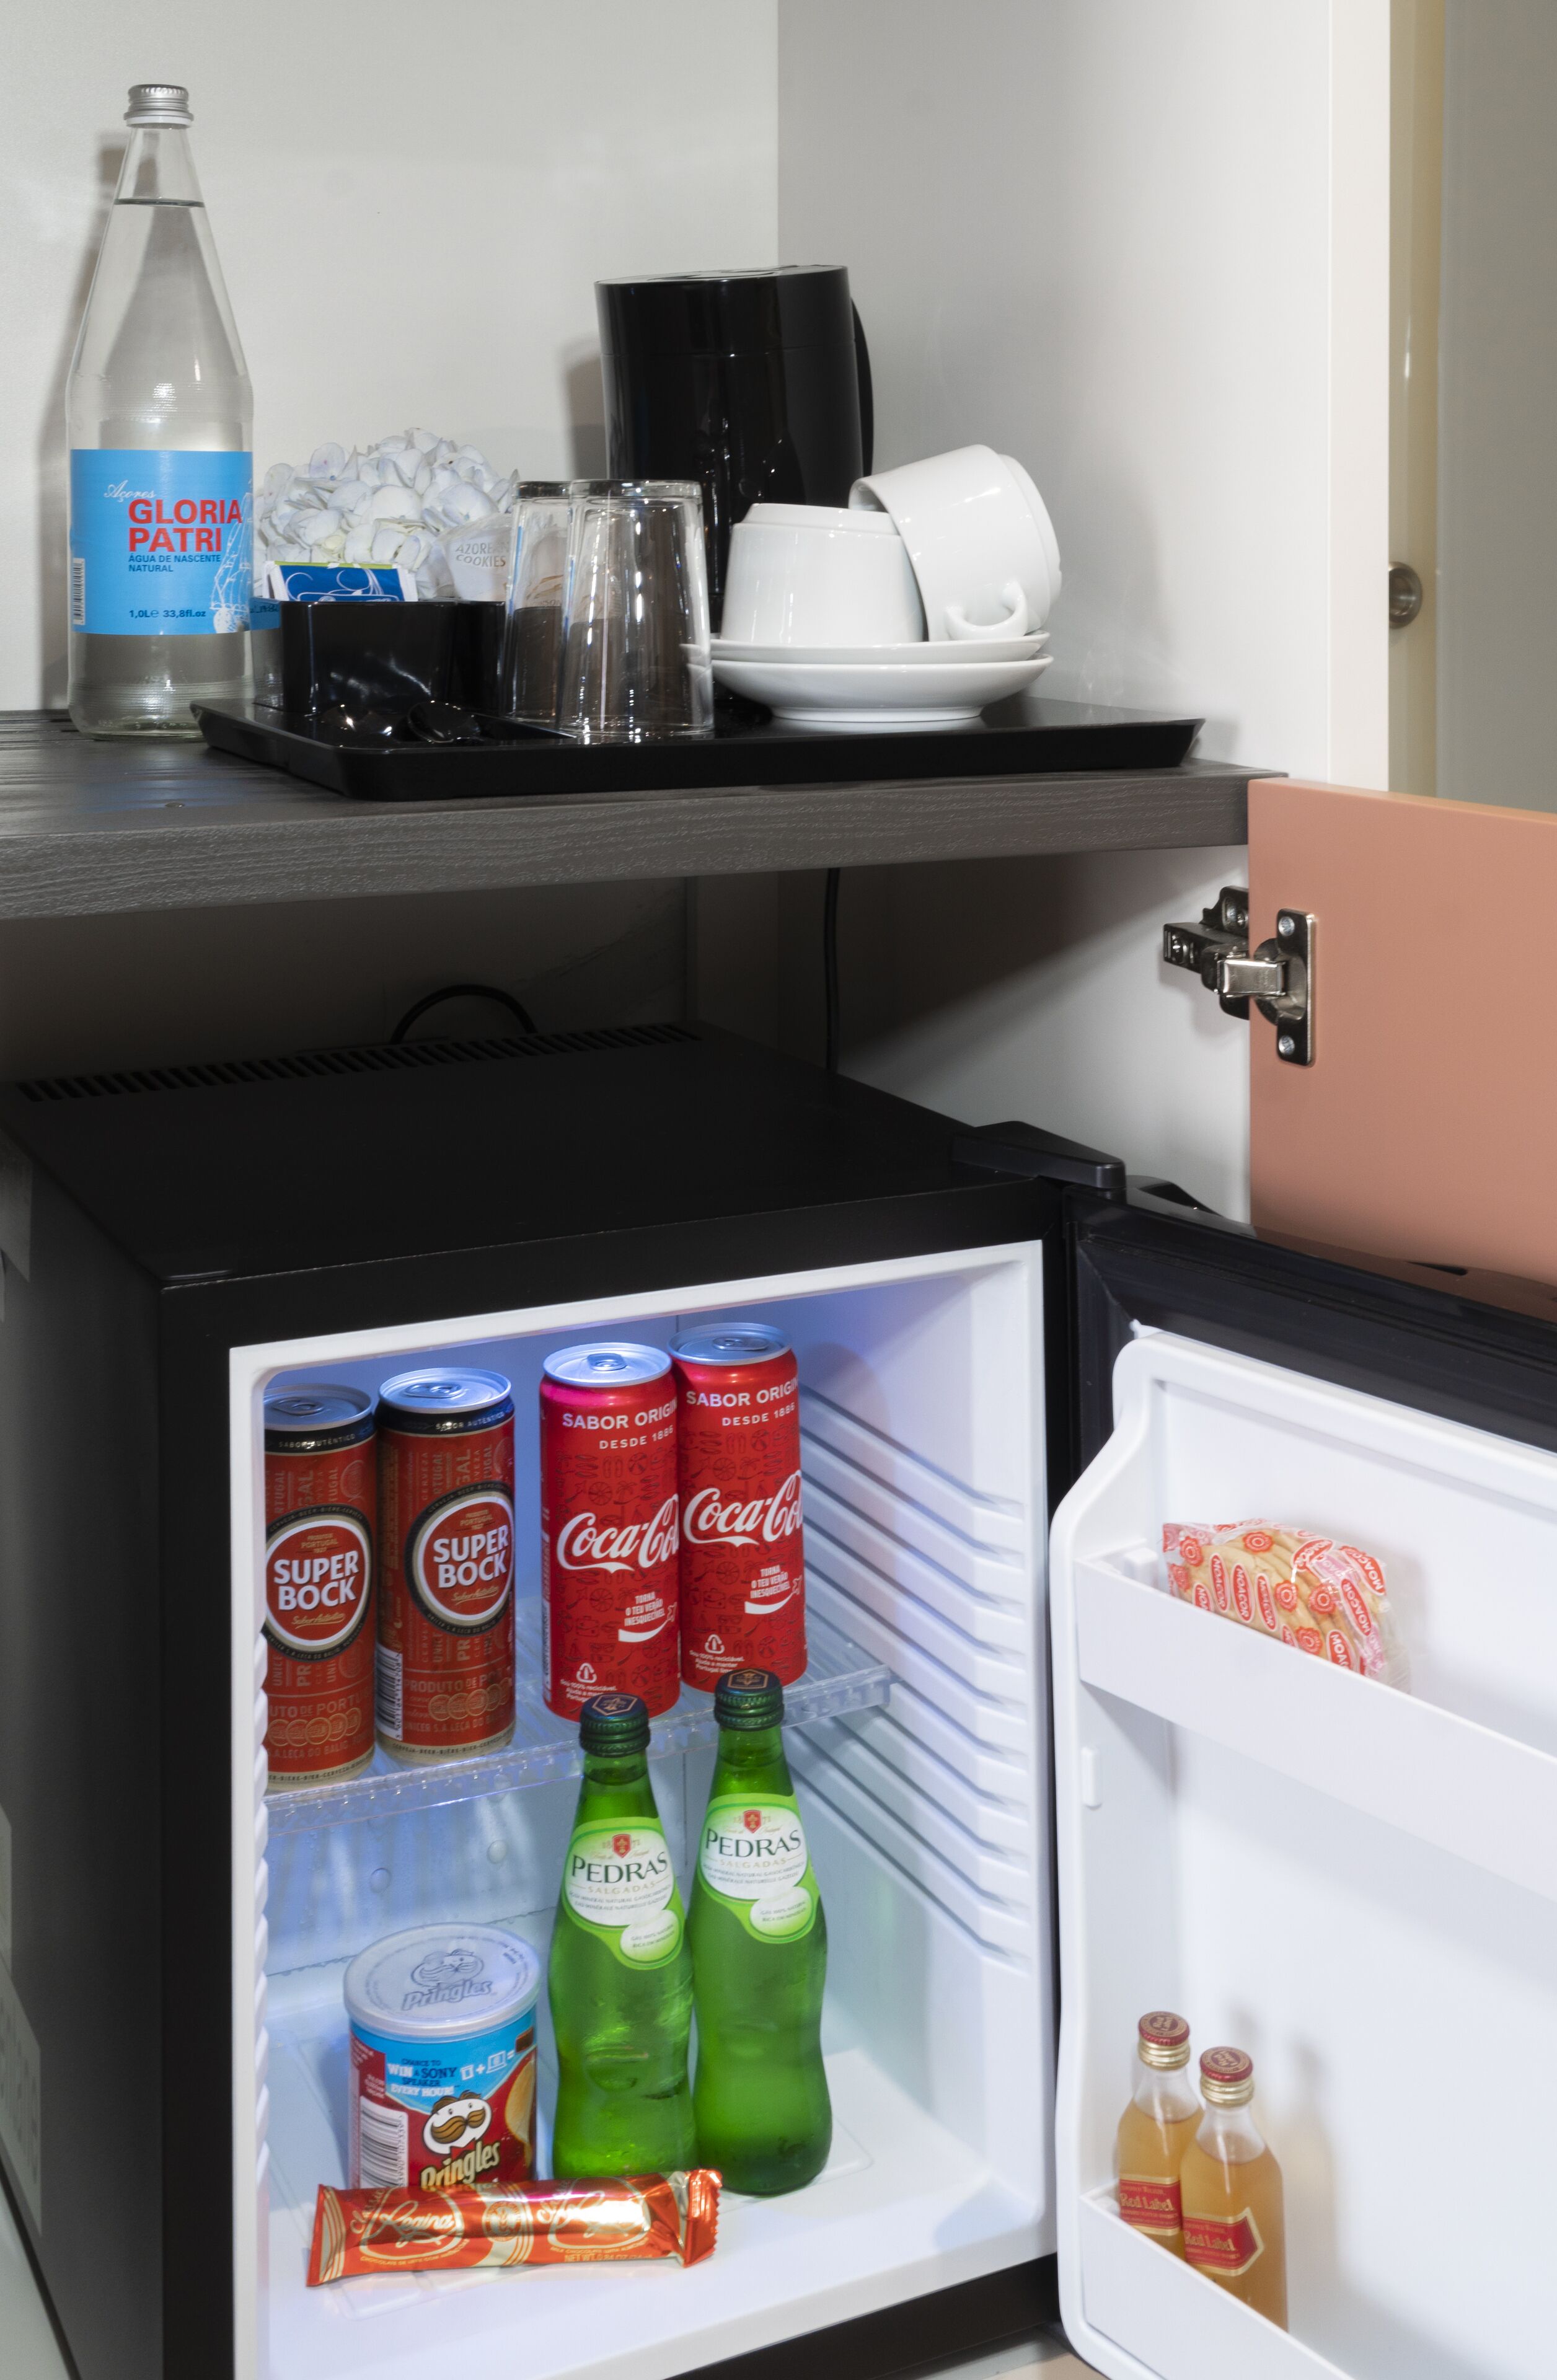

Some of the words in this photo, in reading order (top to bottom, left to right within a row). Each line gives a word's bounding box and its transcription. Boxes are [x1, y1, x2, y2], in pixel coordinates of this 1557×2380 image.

[104, 480, 156, 502] Açores
[128, 499, 243, 524] GLORIA
[128, 527, 222, 552] PATRI
[128, 554, 156, 562] ÁGUA
[456, 555, 506, 568] COOKIES
[686, 1391, 751, 1408] SABOR
[563, 1413, 629, 1430] SABOR
[722, 1413, 769, 1426] DESDE
[599, 1435, 647, 1450] DESDE
[433, 1525, 509, 1563] SUPER
[273, 1550, 359, 1585] SUPER
[438, 1550, 508, 1589] BOCK
[278, 1577, 357, 1611] BOCK
[705, 1828, 802, 1858] PEDRAS
[571, 1851, 668, 1884] PEDRAS
[720, 1856, 788, 1869] SALGADAS
[588, 1880, 656, 1895] SALGADAS
[400, 1980, 493, 2011] Pringles
[402, 2058, 429, 2066] CHANCE
[387, 2063, 413, 2078] WIN
[421, 2066, 458, 2079] SONY
[390, 2083, 420, 2096] EVERY
[402, 2078, 441, 2087] SPEAKER
[421, 2140, 501, 2190] Pringles
[1120, 2193, 1142, 2208] Red
[1142, 2196, 1174, 2211] Label
[1184, 2231, 1206, 2247] Red
[1205, 2234, 1237, 2252] Label
[565, 2254, 580, 2263] NET
